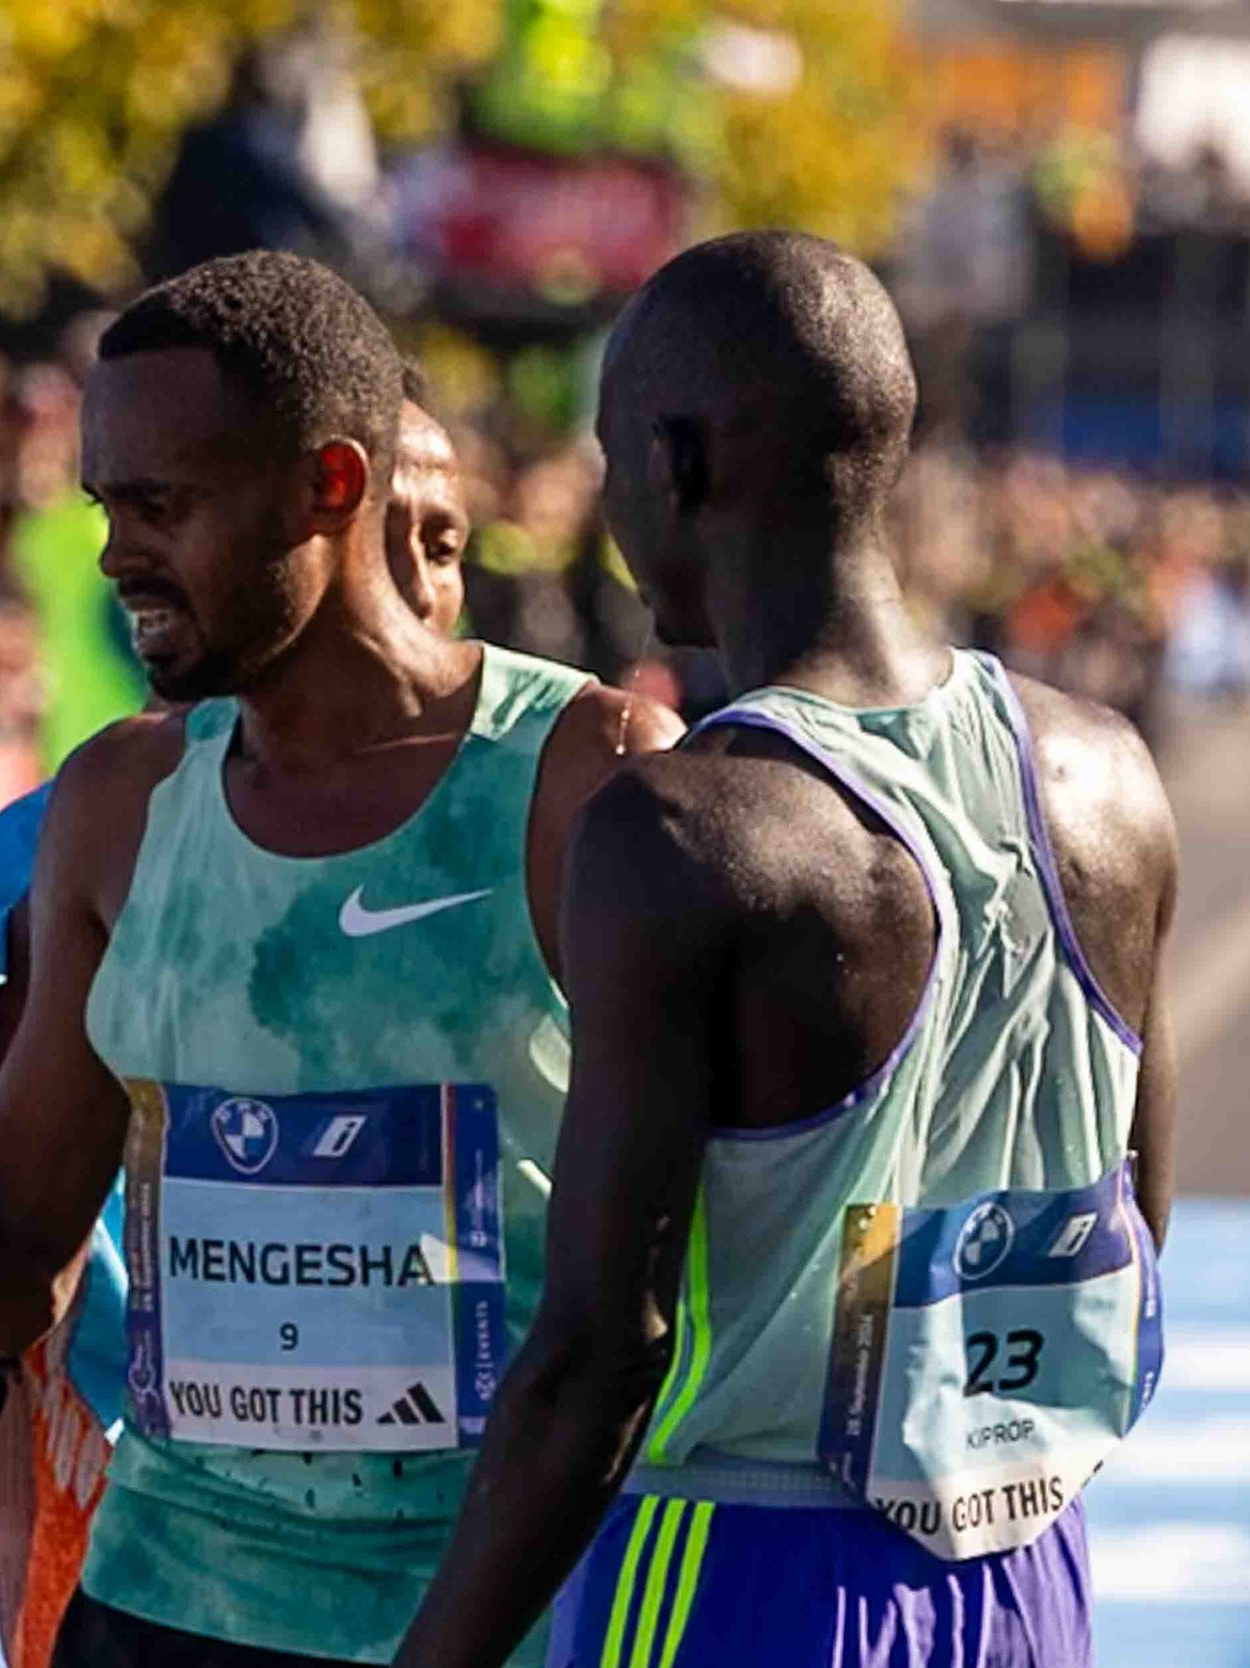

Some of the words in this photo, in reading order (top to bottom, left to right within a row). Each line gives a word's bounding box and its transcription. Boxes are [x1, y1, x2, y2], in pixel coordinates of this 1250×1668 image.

[169, 1236, 435, 1287] MENGESHA
[280, 1323, 299, 1350] 9
[964, 1329, 1044, 1396] 23
[170, 1381, 223, 1418] YOU
[231, 1386, 280, 1422] GOT
[290, 1389, 363, 1424] THIS
[965, 1418, 1035, 1449] KIPROP
[952, 1489, 995, 1532] GOT
[1002, 1476, 1064, 1521] THIS
